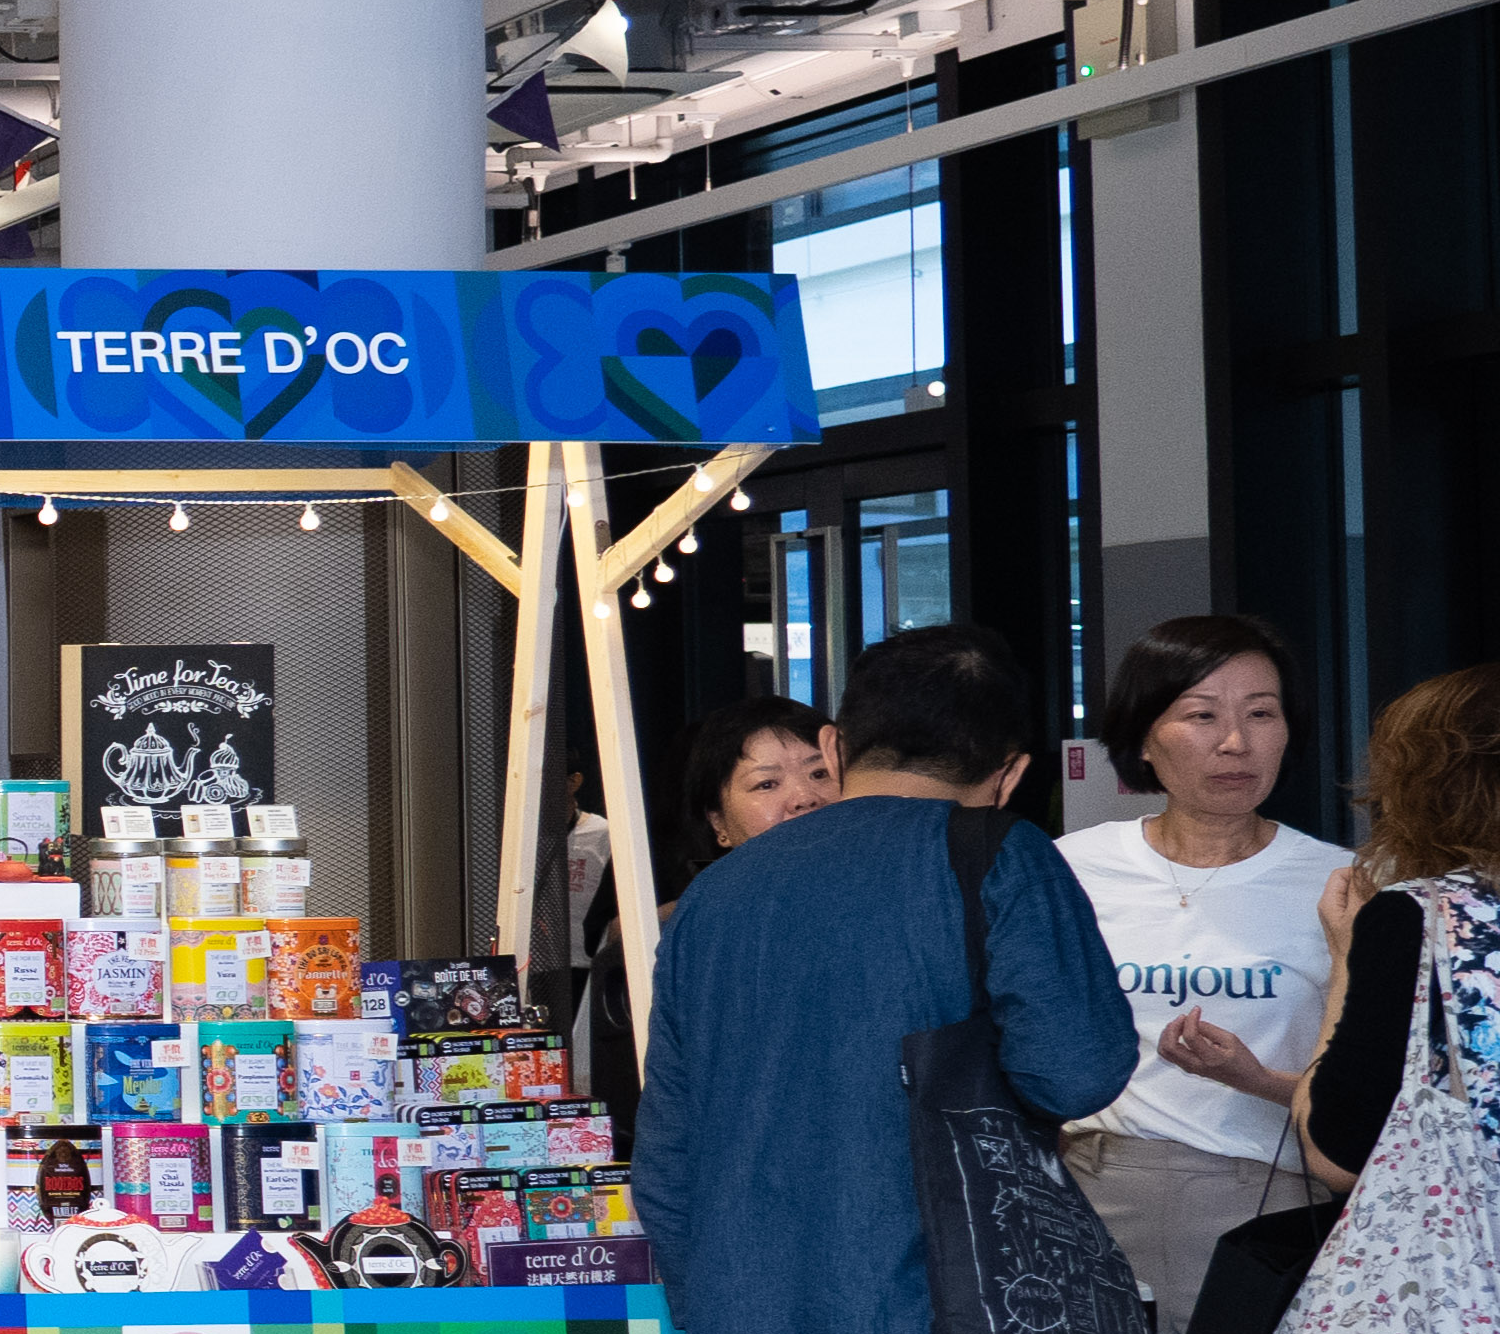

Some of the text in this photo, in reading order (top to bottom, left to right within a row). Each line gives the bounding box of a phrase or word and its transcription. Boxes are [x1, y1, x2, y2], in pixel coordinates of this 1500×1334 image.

[56, 331, 247, 376] TERRE
[113, 659, 240, 696] Time for Tea
[11, 821, 52, 831] MATCHA
[97, 967, 147, 981] JASMIN
[459, 969, 471, 982] DE
[1116, 953, 1283, 1008] onjour
[525, 1254, 569, 1270] terre
